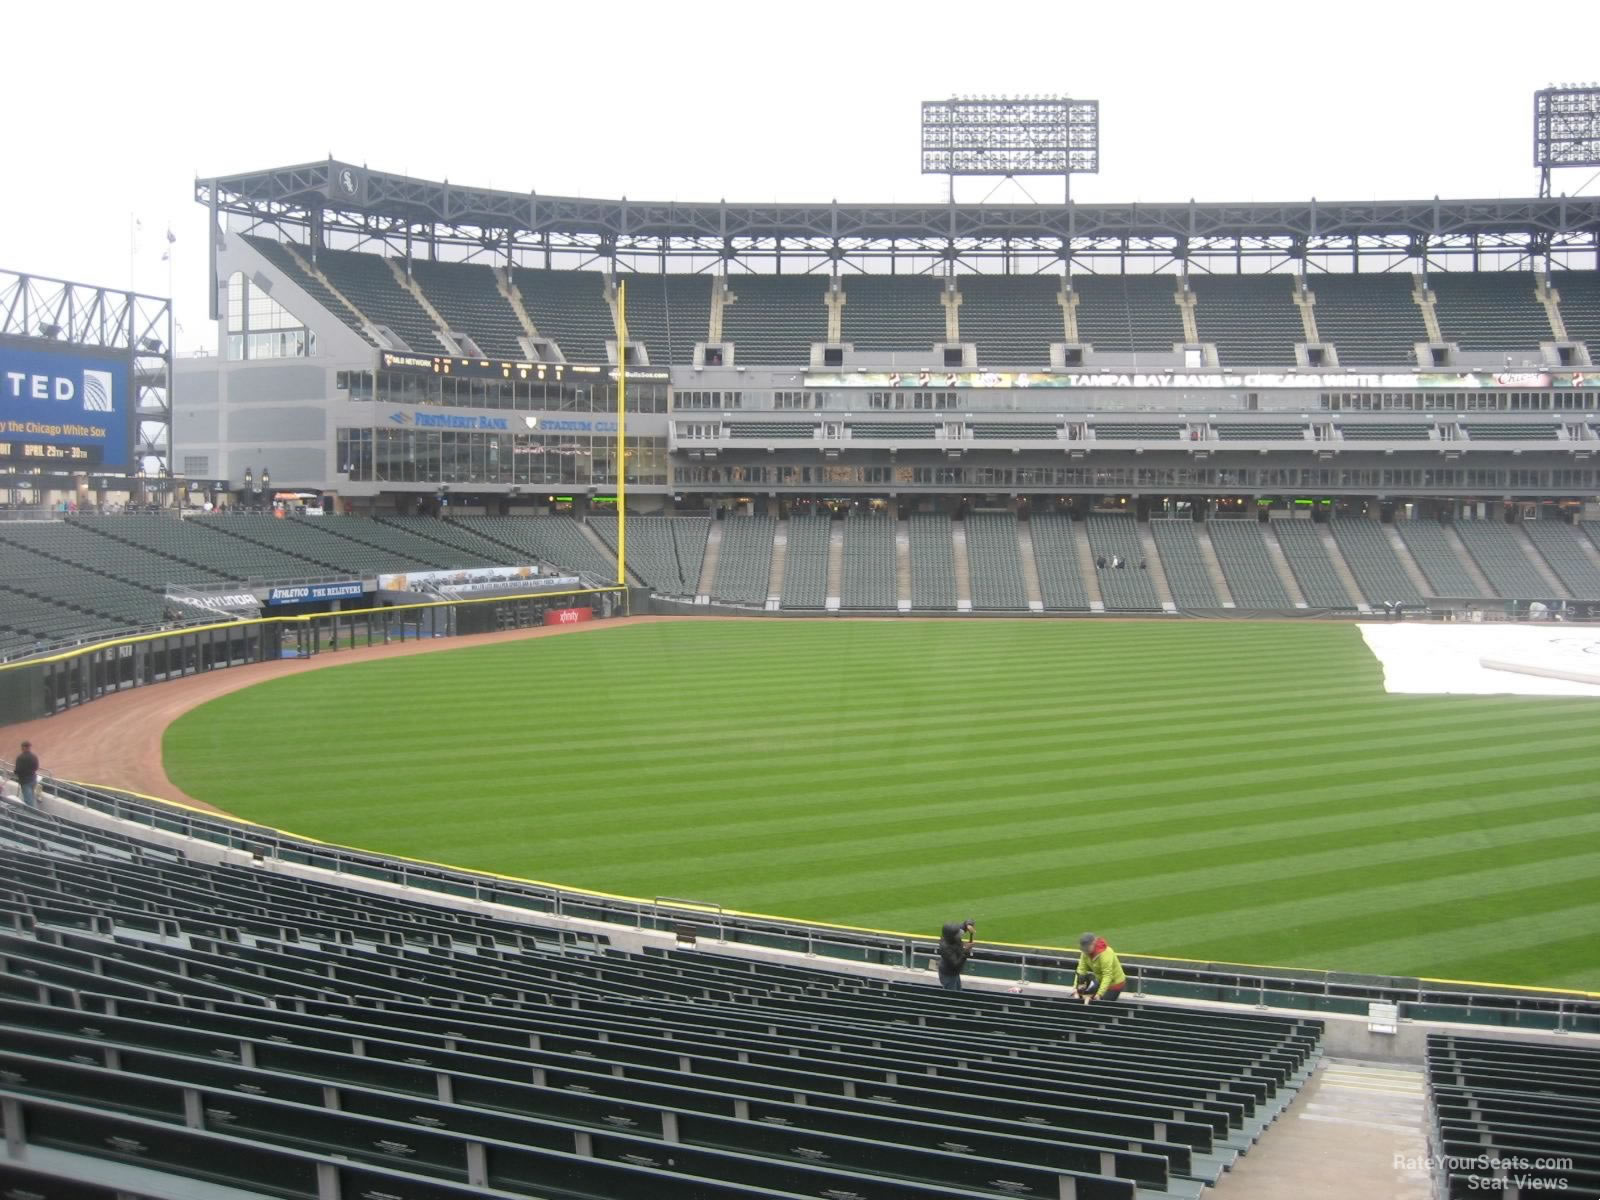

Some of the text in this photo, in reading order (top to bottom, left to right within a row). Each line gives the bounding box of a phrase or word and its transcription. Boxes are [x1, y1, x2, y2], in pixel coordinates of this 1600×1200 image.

[1068, 374, 1131, 387] TAMPA
[1133, 374, 1171, 387] BAY
[1244, 374, 1321, 387] CHICAGO
[1323, 374, 1379, 387] WHITE
[8, 421, 25, 432] the
[26, 422, 61, 437] Chicago
[63, 423, 89, 437] White
[90, 426, 106, 438] Sox
[540, 419, 592, 432] STADIUM
[313, 588, 325, 598] THE
[327, 585, 361, 596] RELIEVERS
[201, 594, 259, 610] HYUNDAI
[560, 609, 578, 624] xfinity
